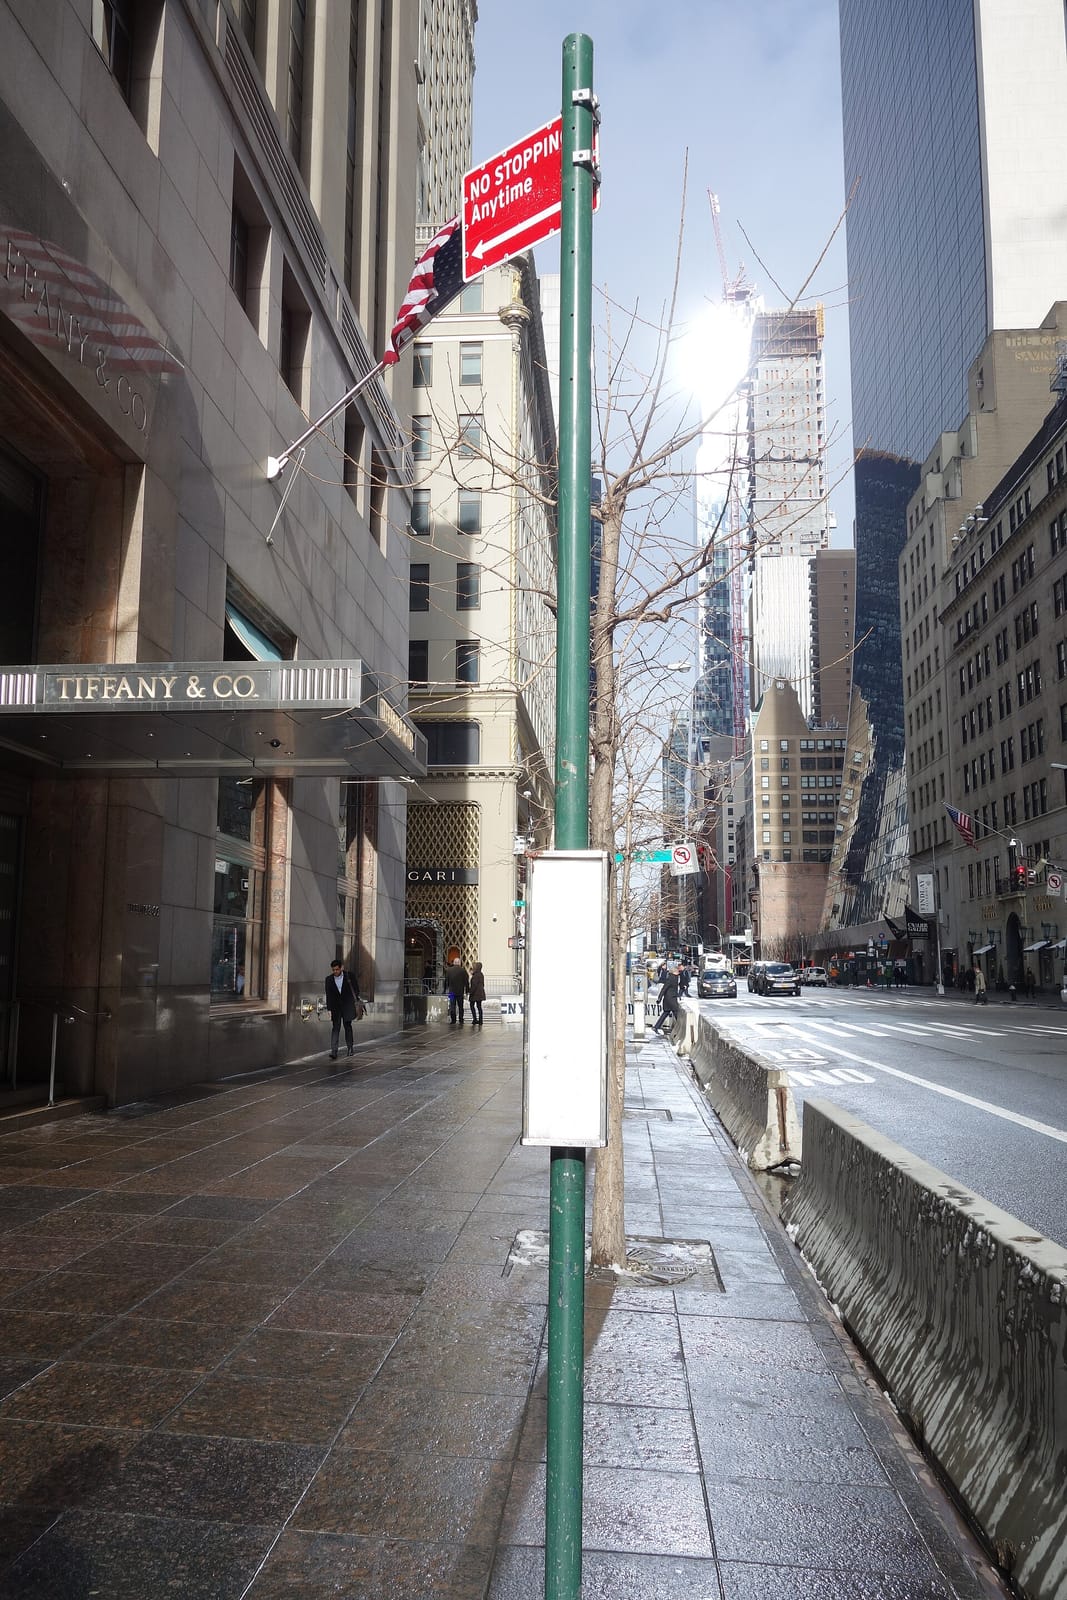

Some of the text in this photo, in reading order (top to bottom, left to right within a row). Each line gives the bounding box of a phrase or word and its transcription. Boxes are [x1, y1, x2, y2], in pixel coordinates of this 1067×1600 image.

[470, 131, 562, 200] NO STOPPIN
[471, 176, 533, 225] Anytime
[56, 674, 259, 699] TIFFANY & CO.
[408, 870, 456, 881] GARI
[644, 1003, 663, 1016] NYP
